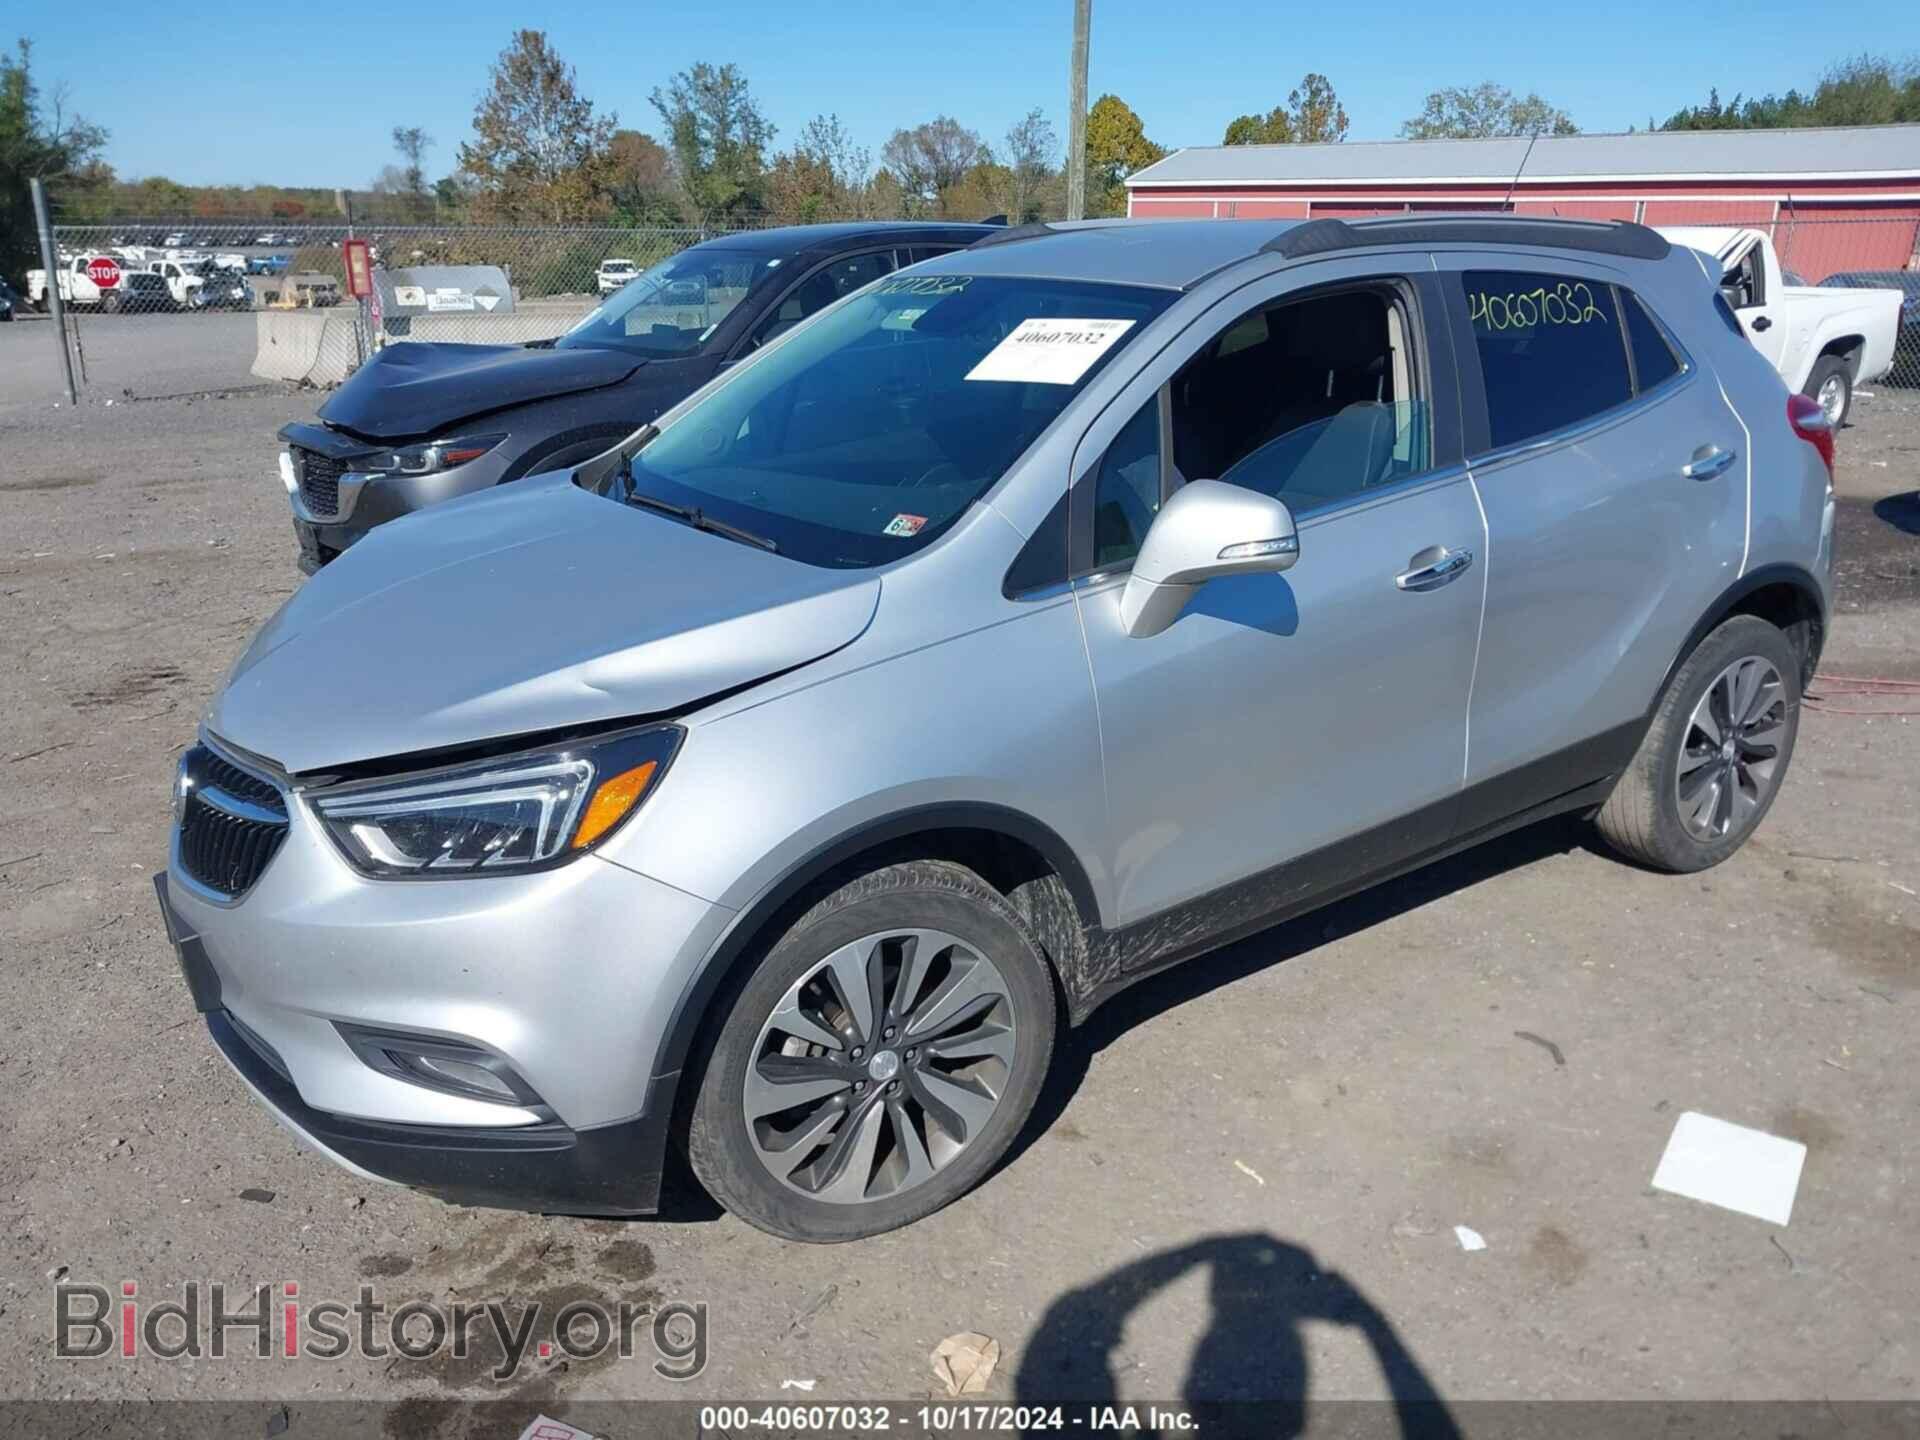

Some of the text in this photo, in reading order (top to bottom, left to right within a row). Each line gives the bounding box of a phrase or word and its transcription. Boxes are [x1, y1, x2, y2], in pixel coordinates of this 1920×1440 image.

[88, 267, 118, 279] STOP
[1470, 283, 1607, 330] 40607032
[1016, 332, 1105, 344] 40607032
